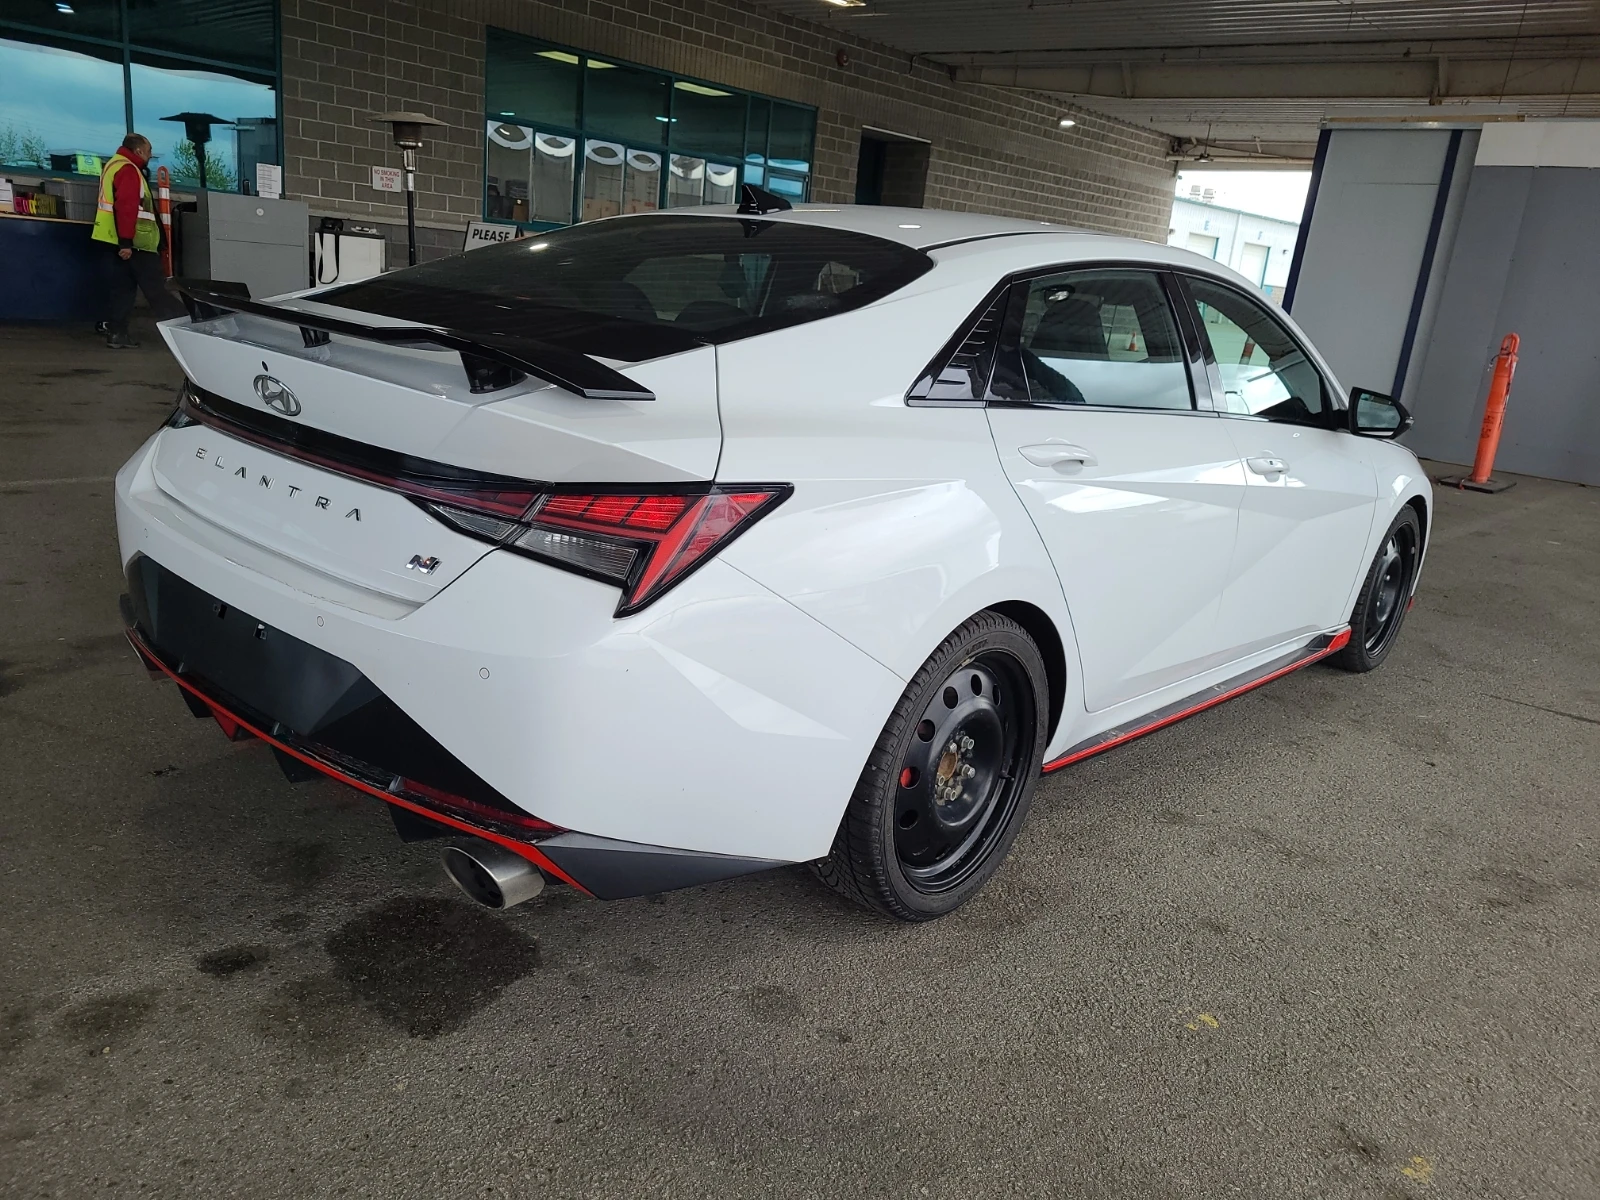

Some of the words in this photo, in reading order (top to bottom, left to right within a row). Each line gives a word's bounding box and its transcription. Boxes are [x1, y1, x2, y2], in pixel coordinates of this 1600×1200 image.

[380, 169, 400, 178] SMOKING
[384, 176, 395, 184] THIS
[472, 228, 510, 242] PLEASE
[195, 447, 362, 522] ELANTRA
[405, 554, 442, 575] N
